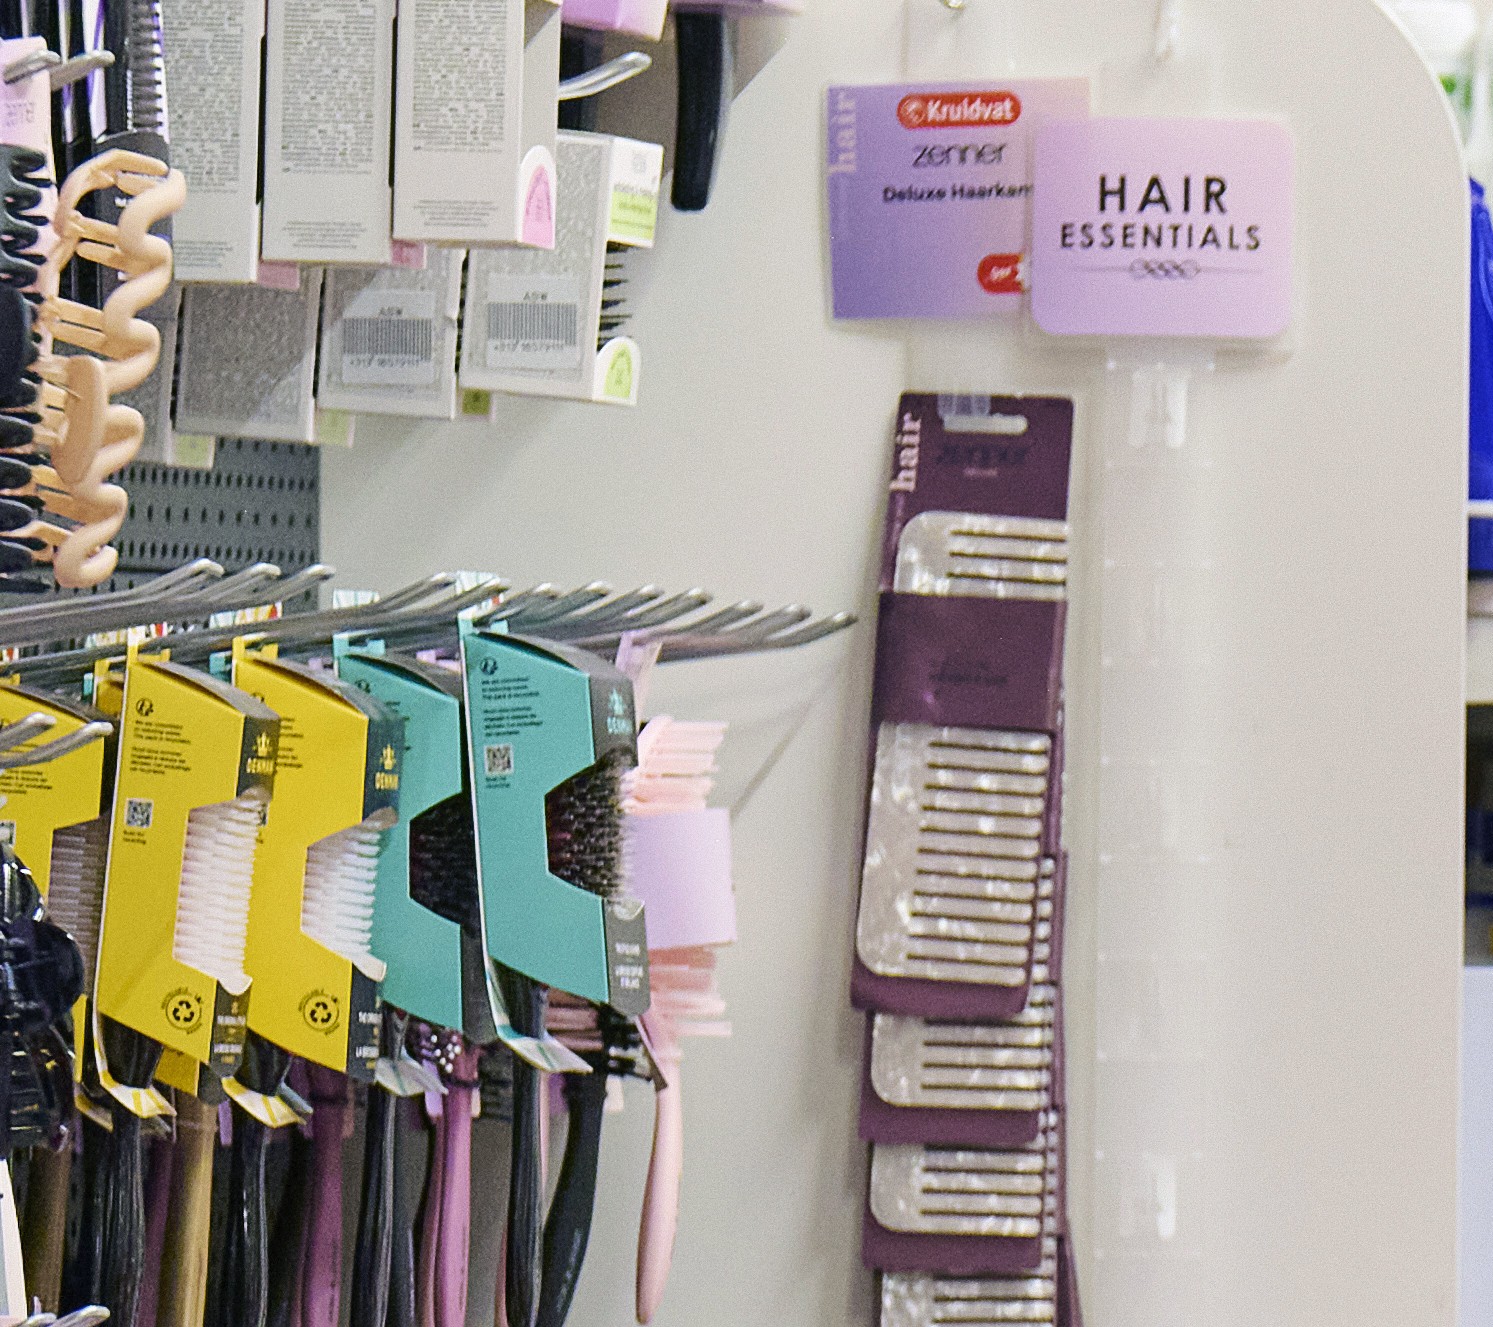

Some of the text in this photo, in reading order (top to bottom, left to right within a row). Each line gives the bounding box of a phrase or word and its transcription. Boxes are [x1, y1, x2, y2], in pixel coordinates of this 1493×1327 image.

[926, 98, 1014, 123] Kruidvat
[912, 142, 1007, 168] zenner
[882, 184, 947, 203] Deluxe
[1099, 174, 1228, 214] HAIR
[1060, 222, 1261, 251] ESSENTIALS
[889, 411, 922, 493] hair
